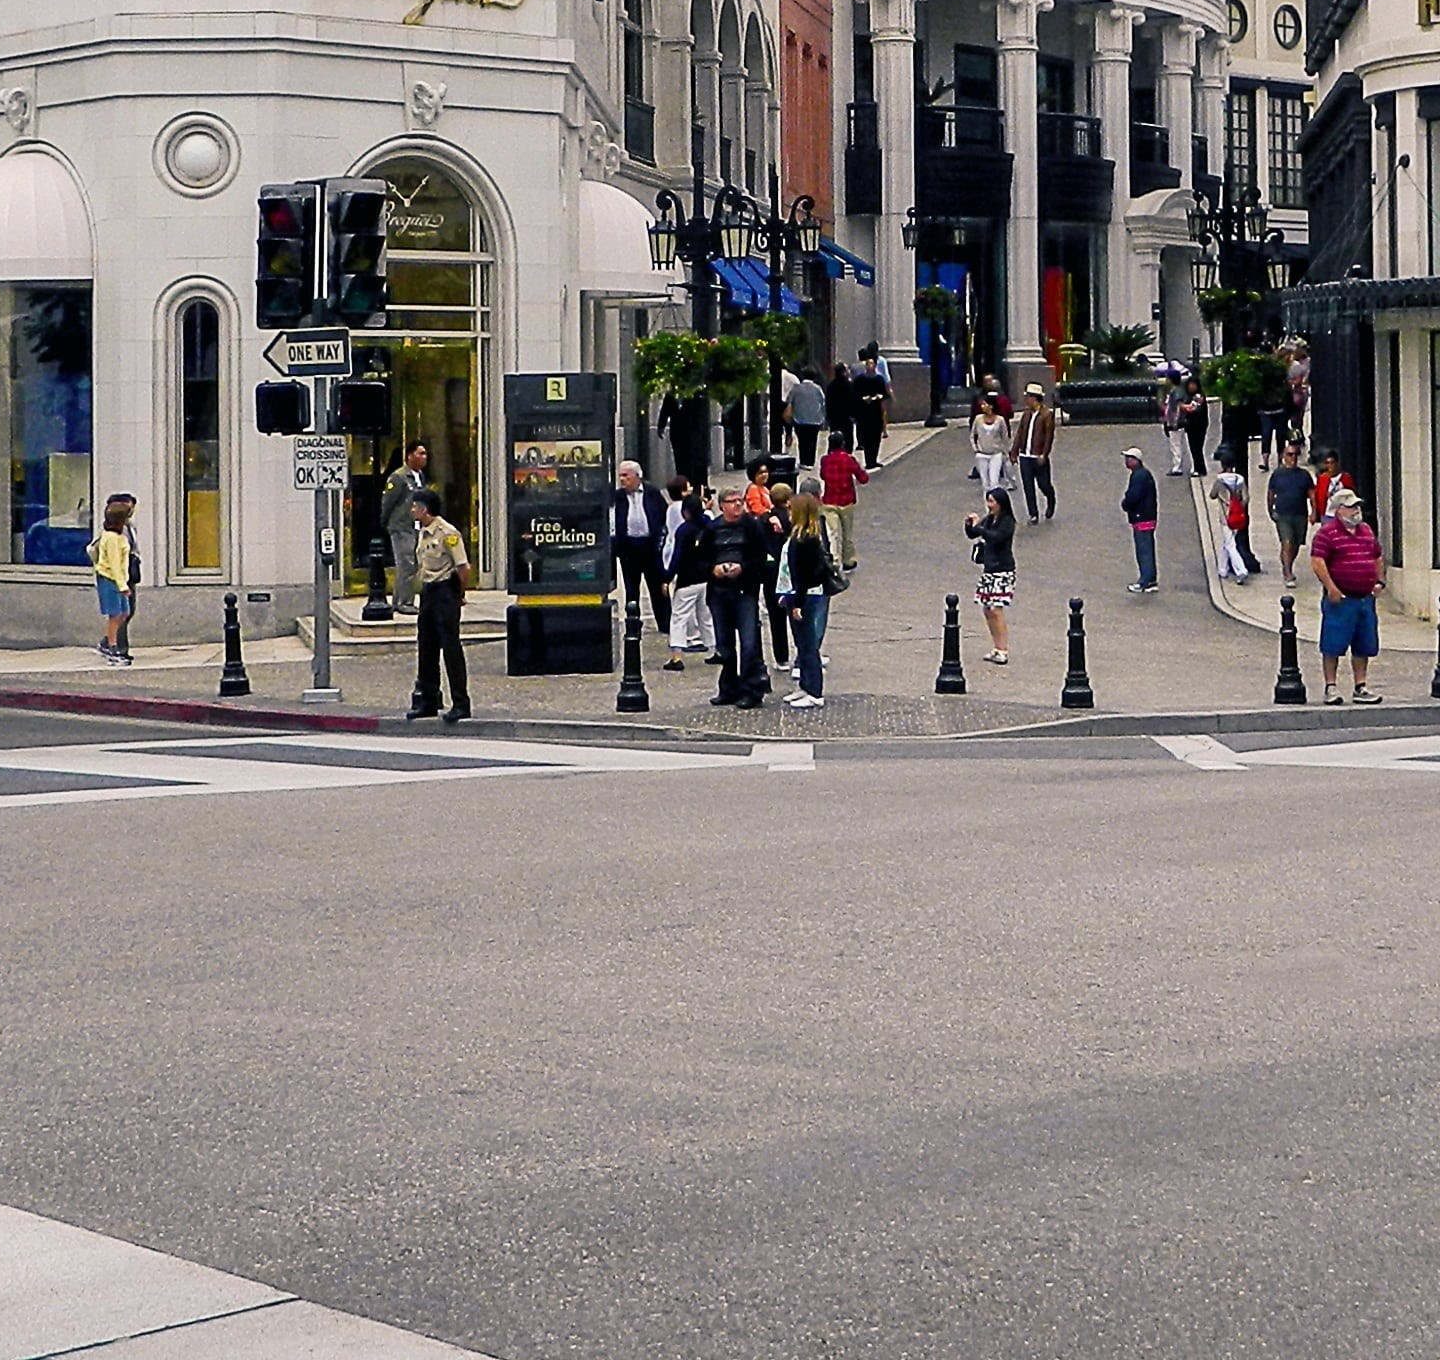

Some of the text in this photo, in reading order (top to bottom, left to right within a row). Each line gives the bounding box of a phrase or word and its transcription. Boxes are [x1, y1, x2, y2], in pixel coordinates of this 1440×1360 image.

[288, 343, 341, 362] ONE WAY
[297, 438, 345, 448] DIAGONAL
[296, 449, 347, 460] CROSSING
[296, 467, 316, 484] OK
[530, 518, 562, 532] free
[535, 528, 596, 547] parking
